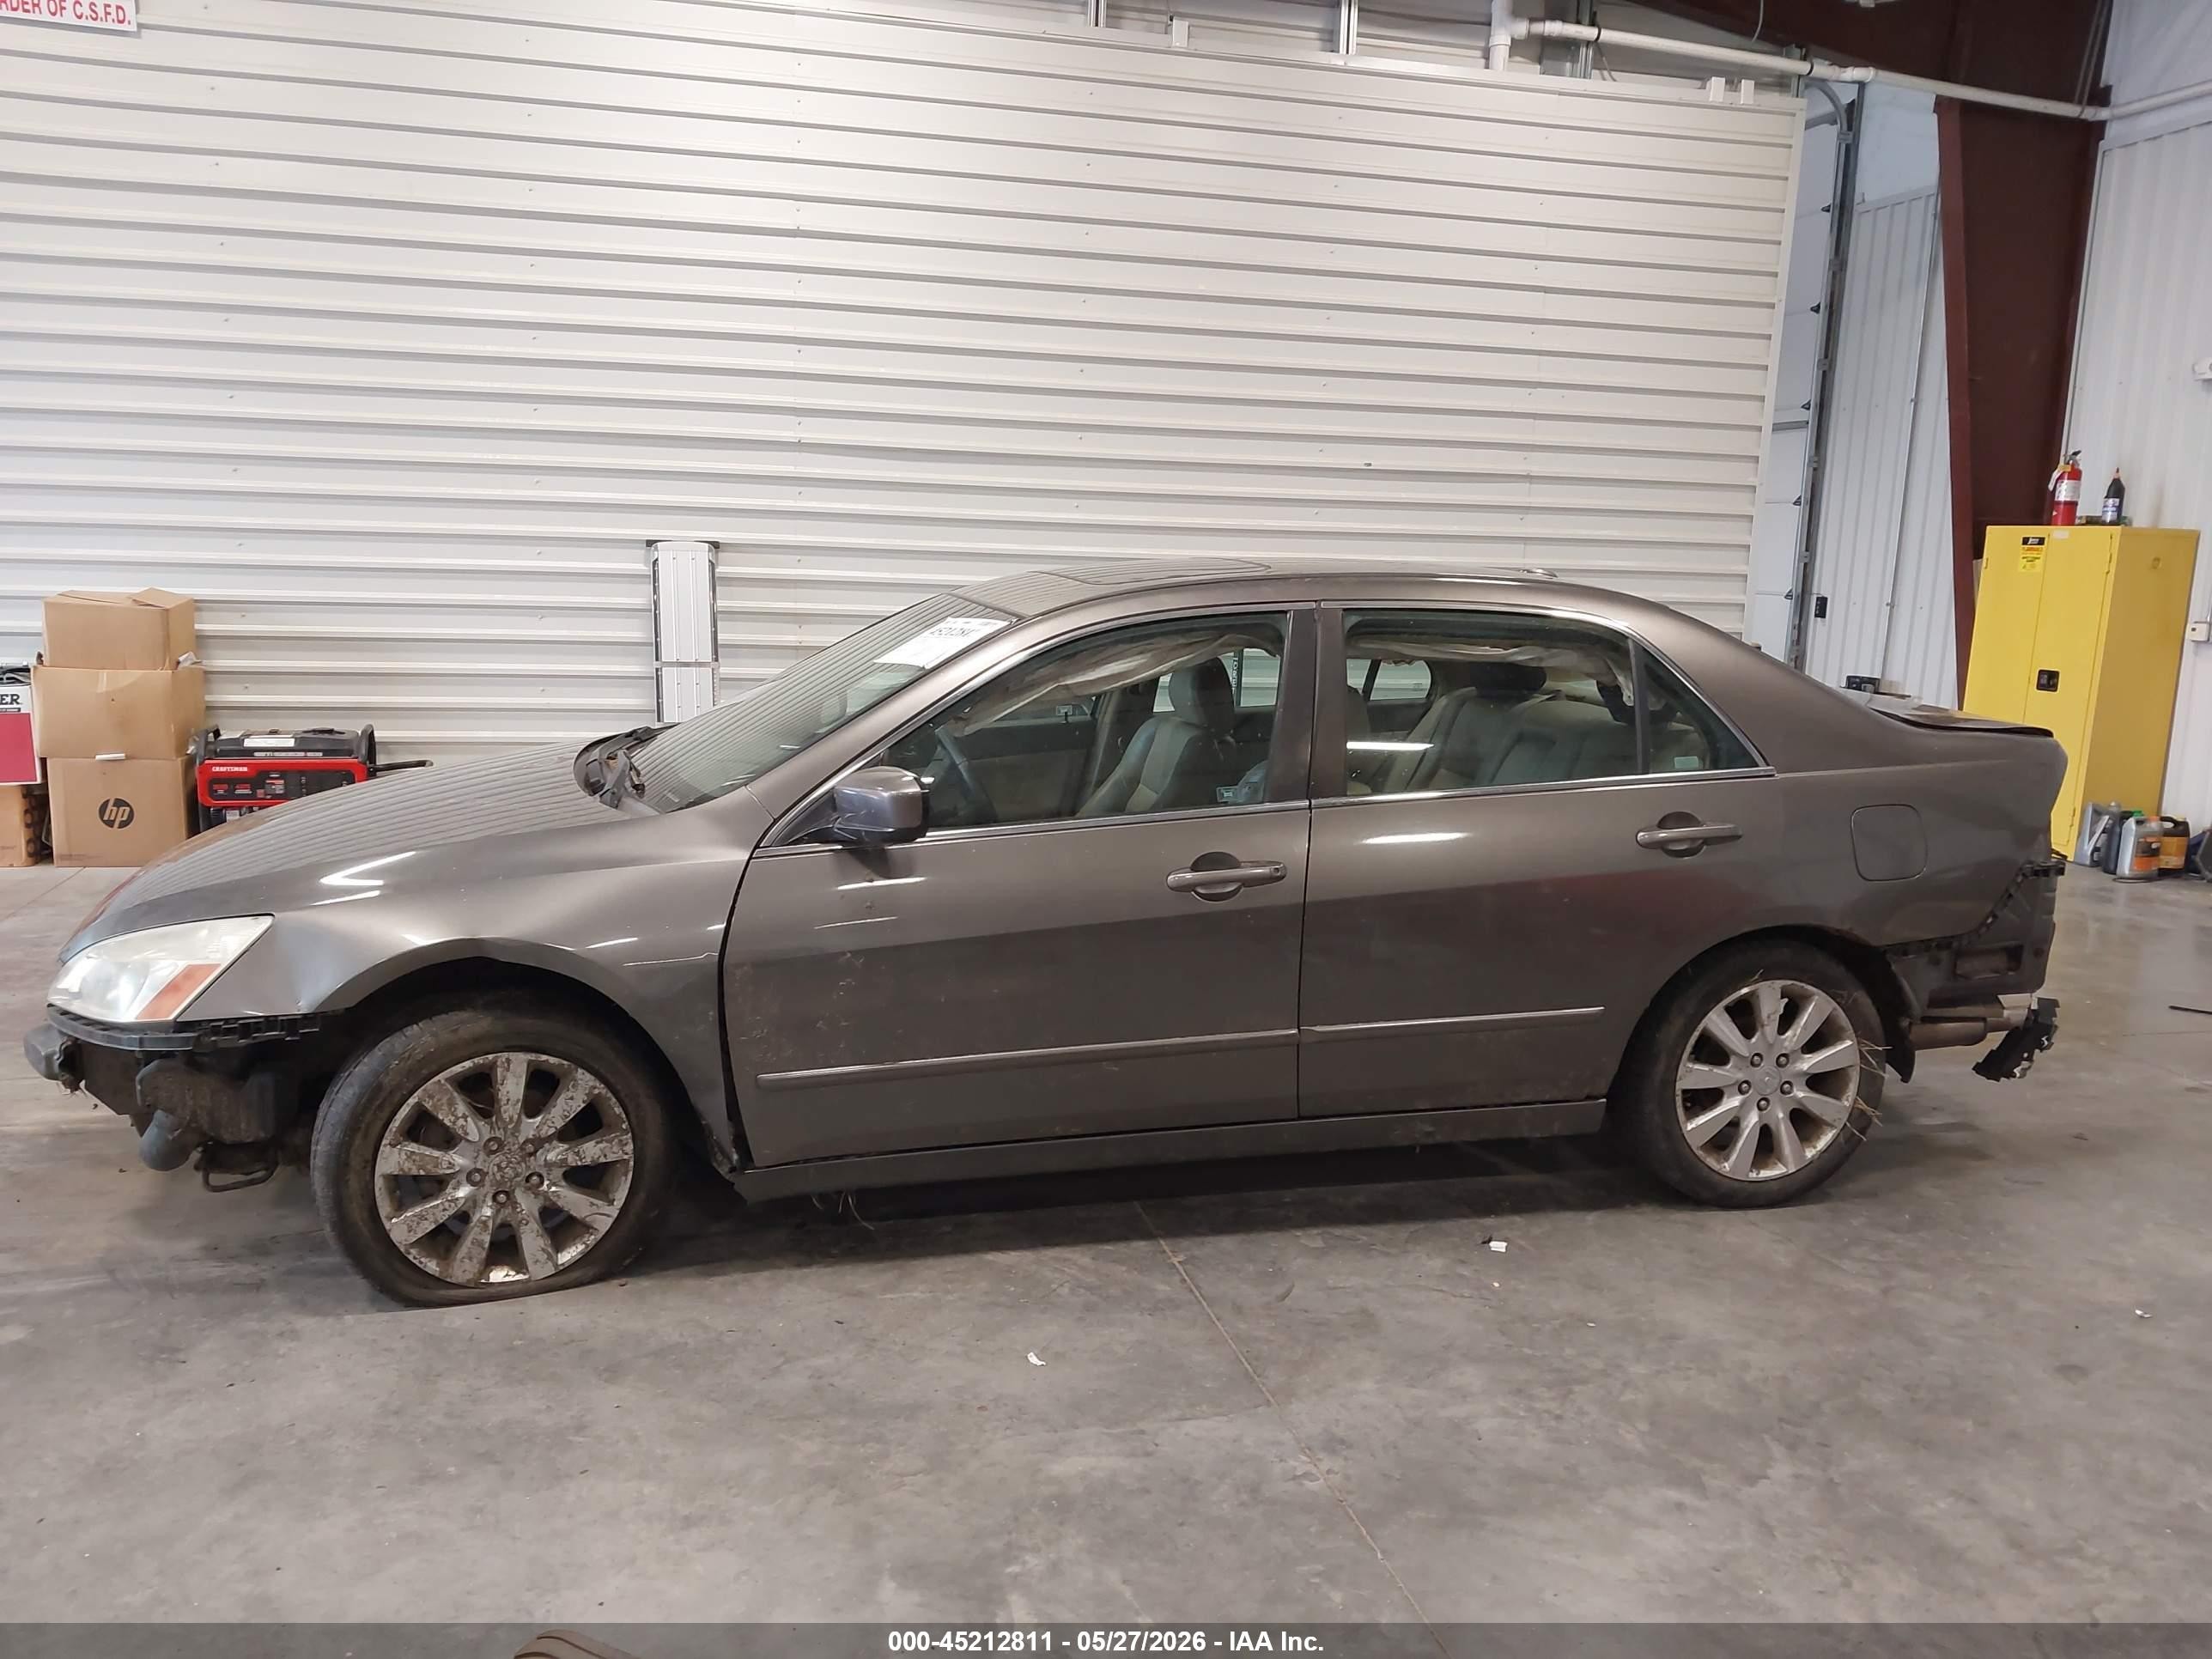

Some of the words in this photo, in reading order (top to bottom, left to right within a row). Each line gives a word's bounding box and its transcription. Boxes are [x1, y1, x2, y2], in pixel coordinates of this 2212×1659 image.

[47, 0, 67, 17] OF
[73, 1, 131, 25] C.S.F.D.
[102, 798, 131, 829] hp
